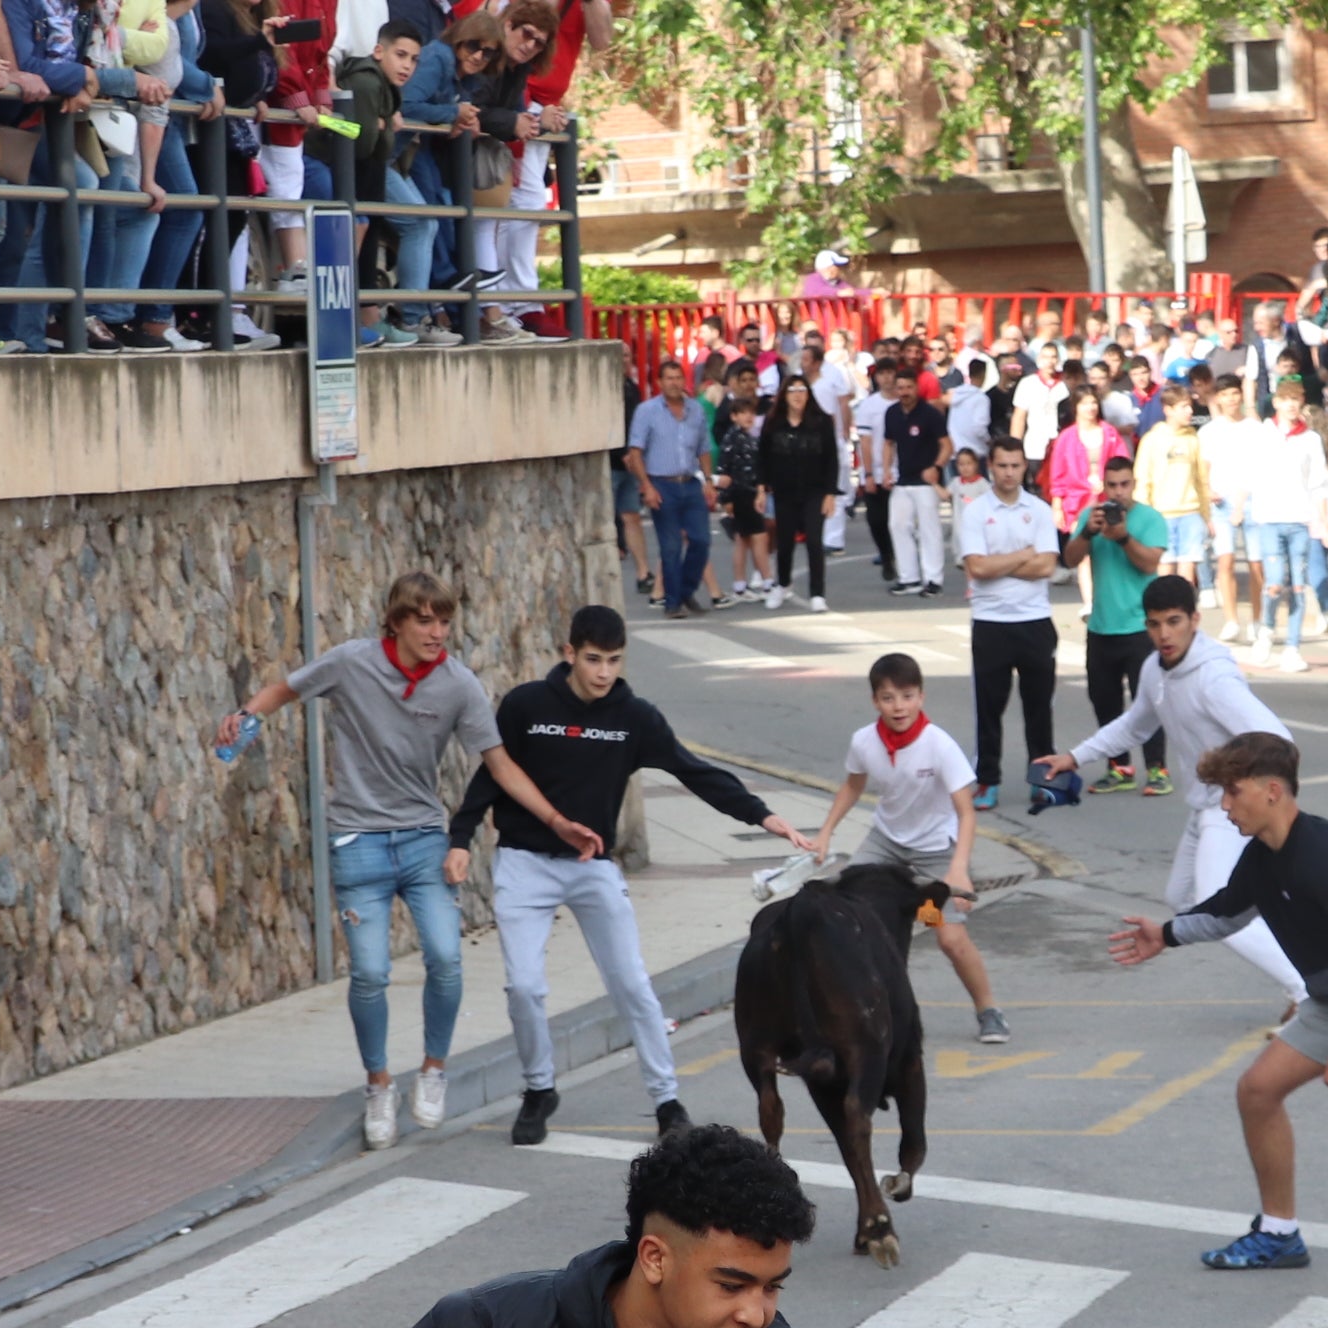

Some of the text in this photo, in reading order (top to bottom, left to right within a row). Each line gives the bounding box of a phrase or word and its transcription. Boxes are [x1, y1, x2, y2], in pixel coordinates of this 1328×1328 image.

[316, 265, 351, 310] TAXI
[527, 724, 567, 736] JACK
[580, 728, 627, 741] JONES
